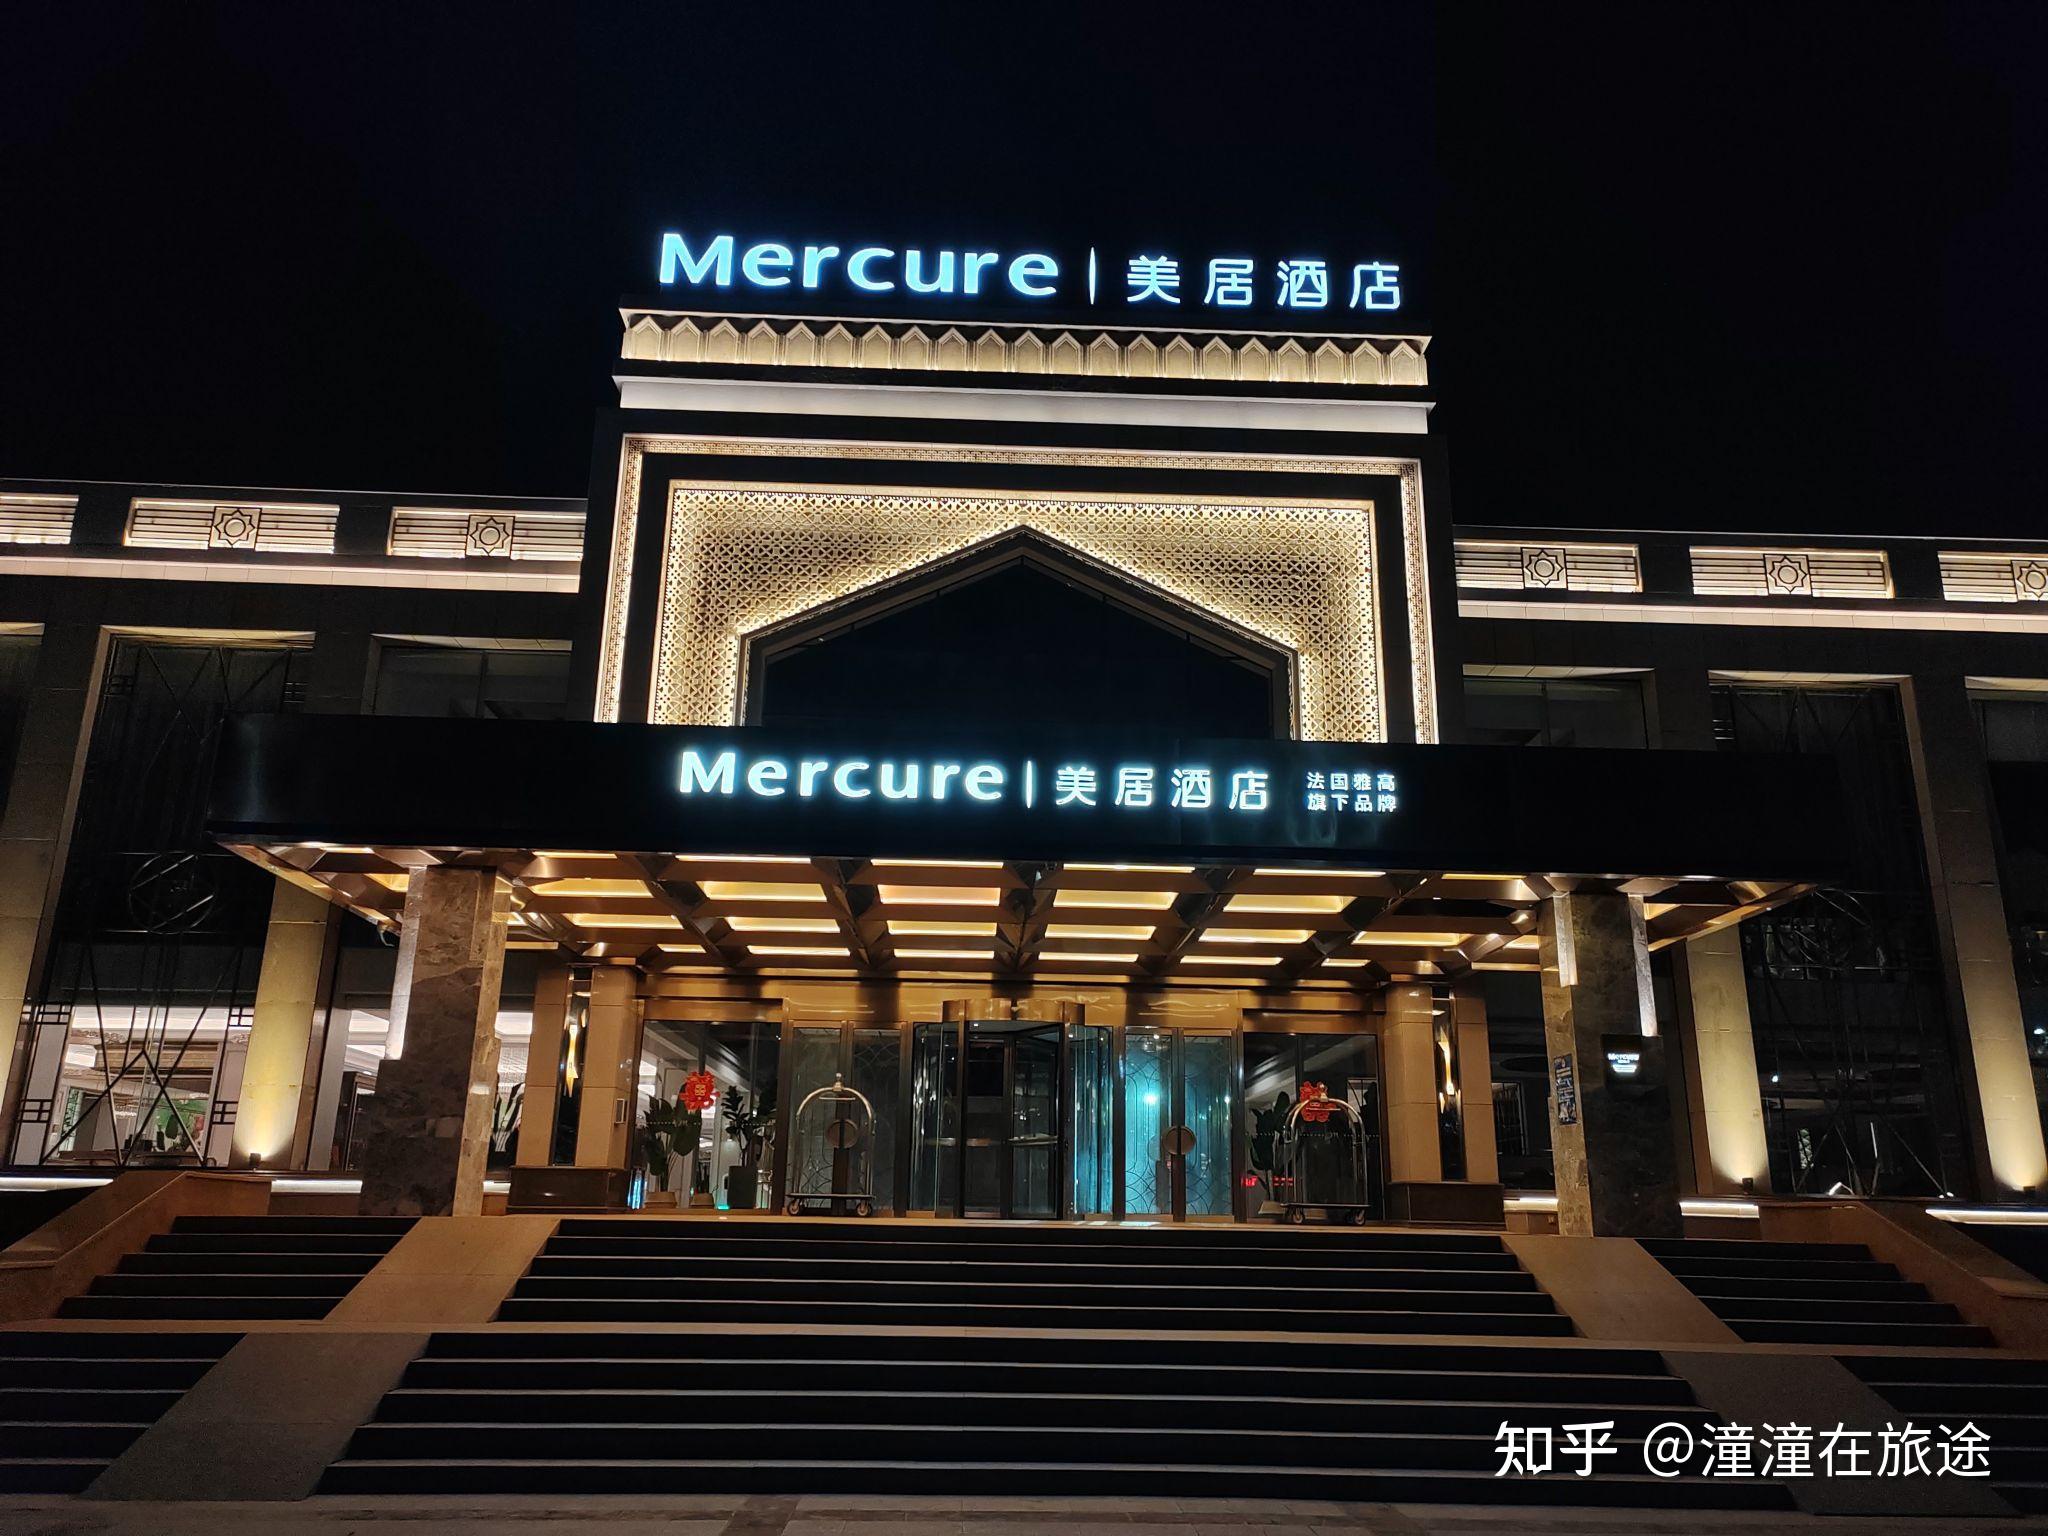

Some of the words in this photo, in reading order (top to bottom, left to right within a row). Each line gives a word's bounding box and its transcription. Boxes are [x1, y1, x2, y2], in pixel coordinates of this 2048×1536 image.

[659, 232, 1059, 297] Mercure
[1127, 255, 1401, 310] 美居酒店
[679, 749, 1006, 801] Mercure
[1055, 765, 1269, 811] 美居酒店
[1306, 771, 1396, 791] 法国雅高
[1307, 793, 1397, 812] 旗下品牌
